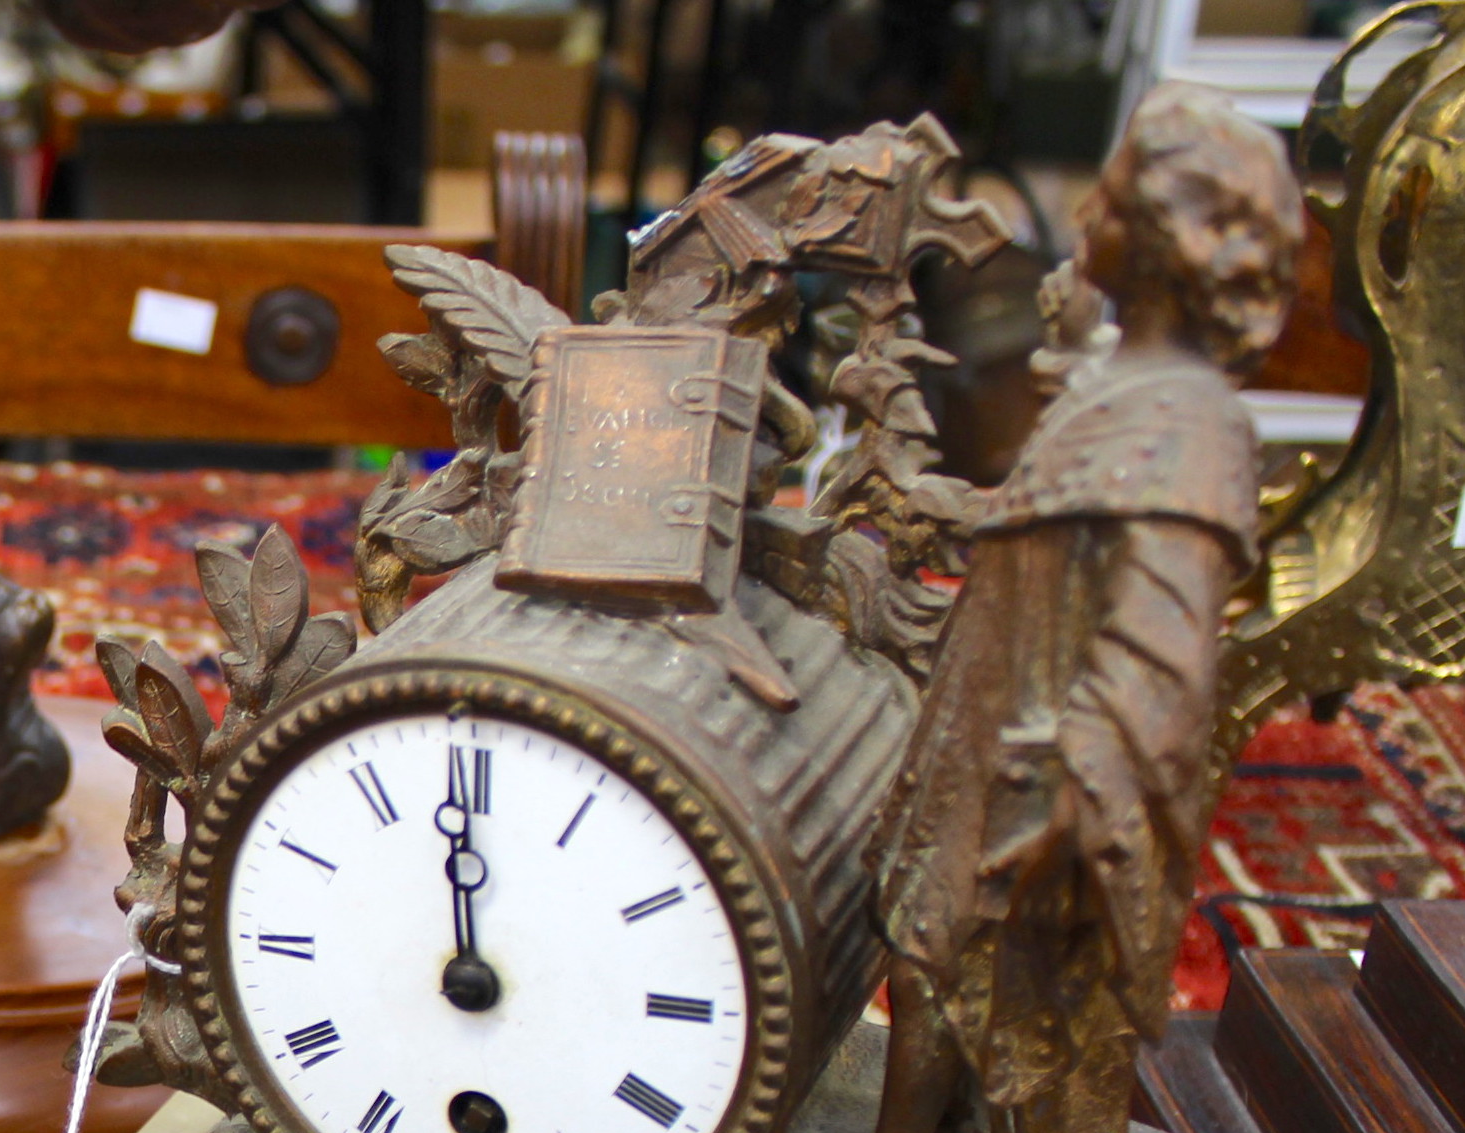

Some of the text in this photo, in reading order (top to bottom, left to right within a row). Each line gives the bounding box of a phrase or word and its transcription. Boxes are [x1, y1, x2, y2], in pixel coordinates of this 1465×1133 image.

[348, 760, 404, 833] XI
[619, 885, 686, 924] II
[257, 926, 315, 961] IX
[645, 992, 714, 1024] III
